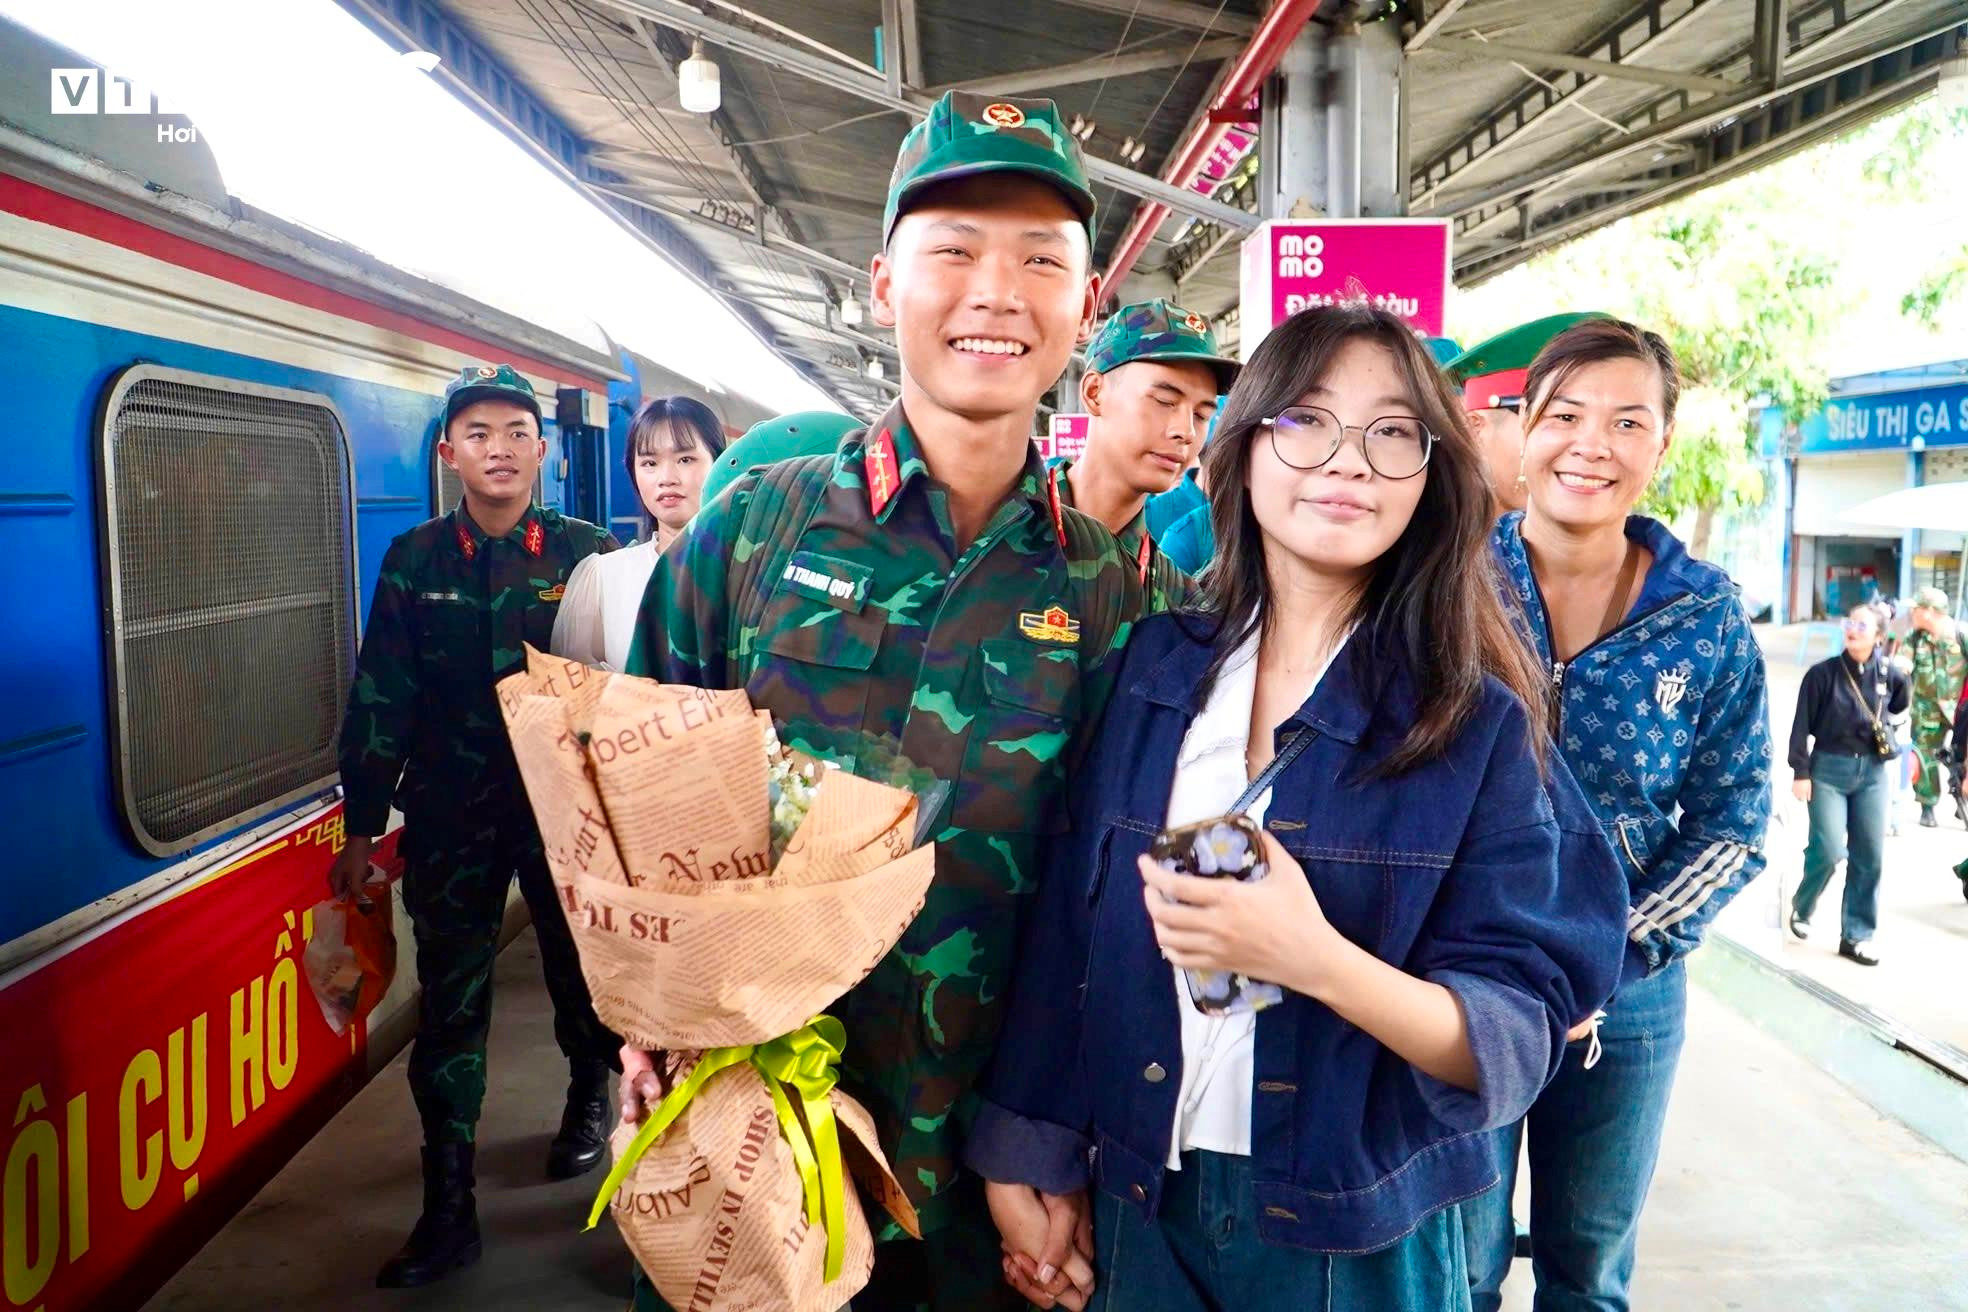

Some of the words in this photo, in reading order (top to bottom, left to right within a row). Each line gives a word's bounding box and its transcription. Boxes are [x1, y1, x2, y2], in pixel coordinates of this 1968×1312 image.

[1827, 401, 1870, 440] SIÊU
[1876, 404, 1909, 445] THỊ
[1915, 400, 1951, 434] GA
[119, 1012, 207, 1211] CỤ
[735, 1106, 773, 1182] SHOP
[722, 1189, 745, 1220] IN
